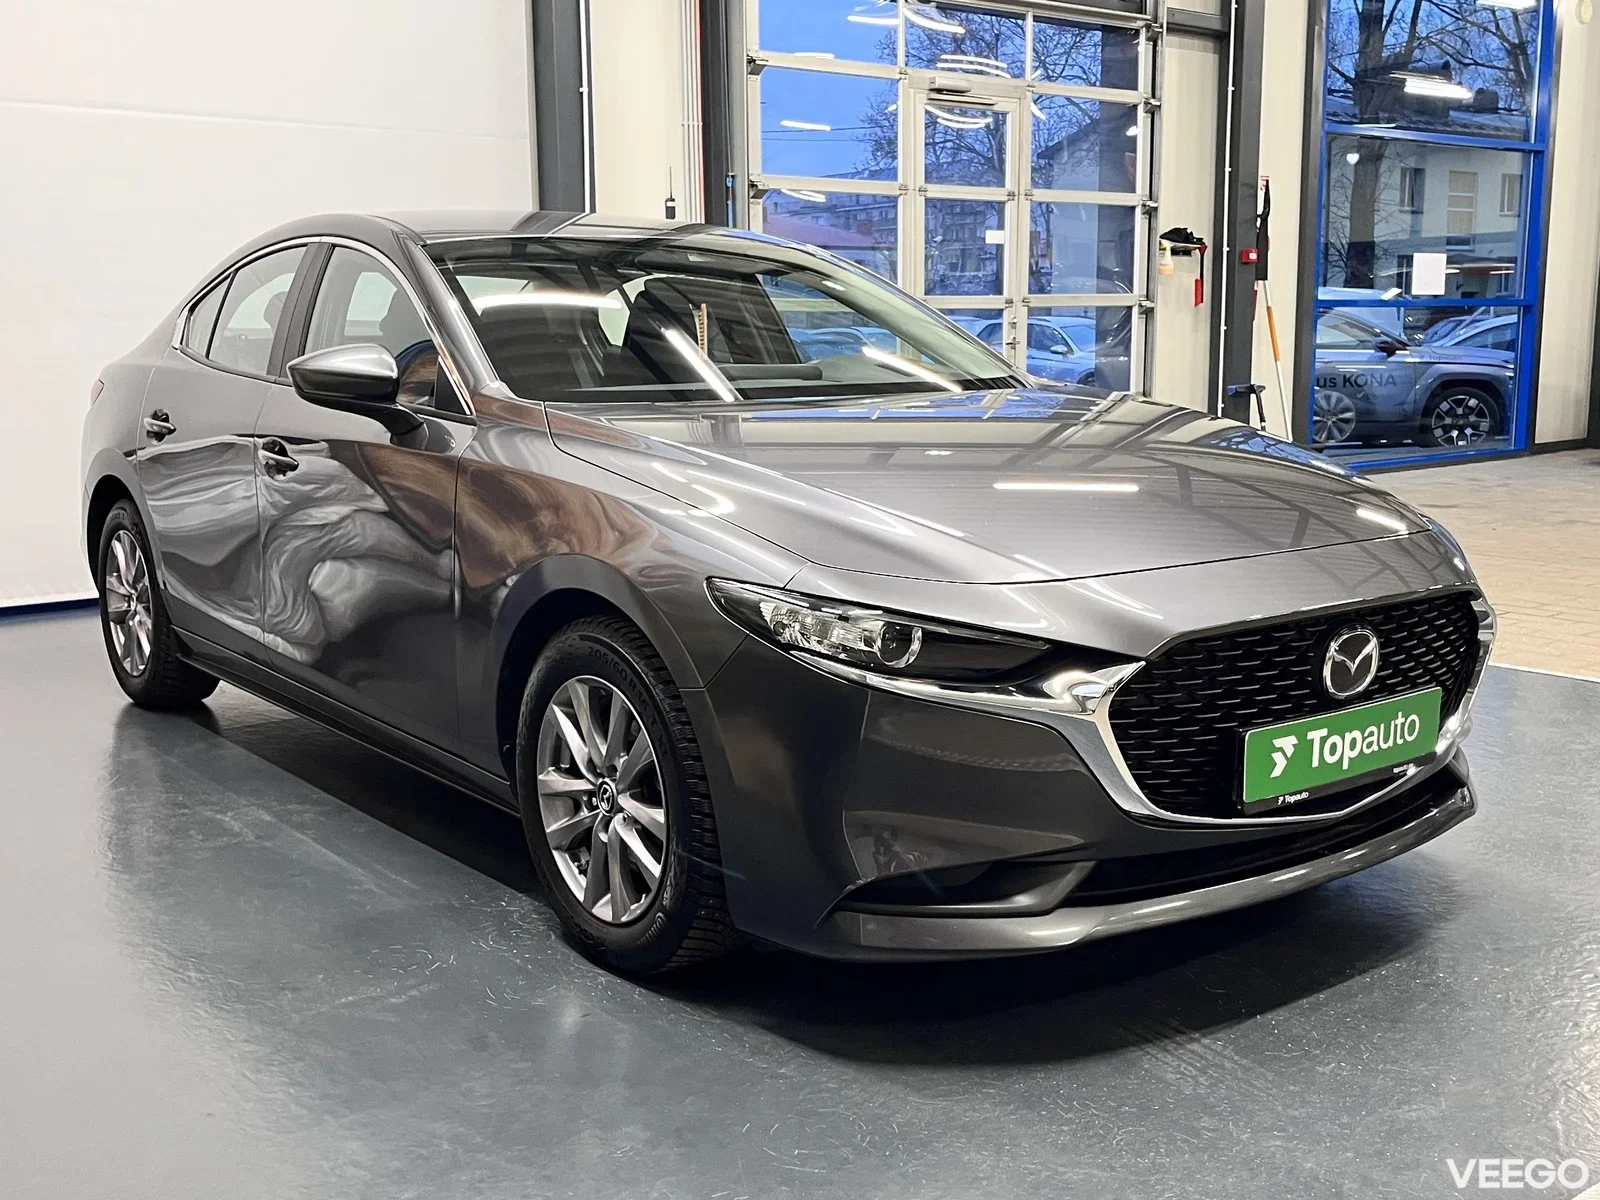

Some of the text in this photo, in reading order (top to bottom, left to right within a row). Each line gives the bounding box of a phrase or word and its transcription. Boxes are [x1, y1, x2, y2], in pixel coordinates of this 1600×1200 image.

[1316, 373, 1397, 389] us KONA
[587, 646, 628, 681] 205/60
[1306, 711, 1420, 770] Topauto
[1284, 791, 1309, 804] Topauto
